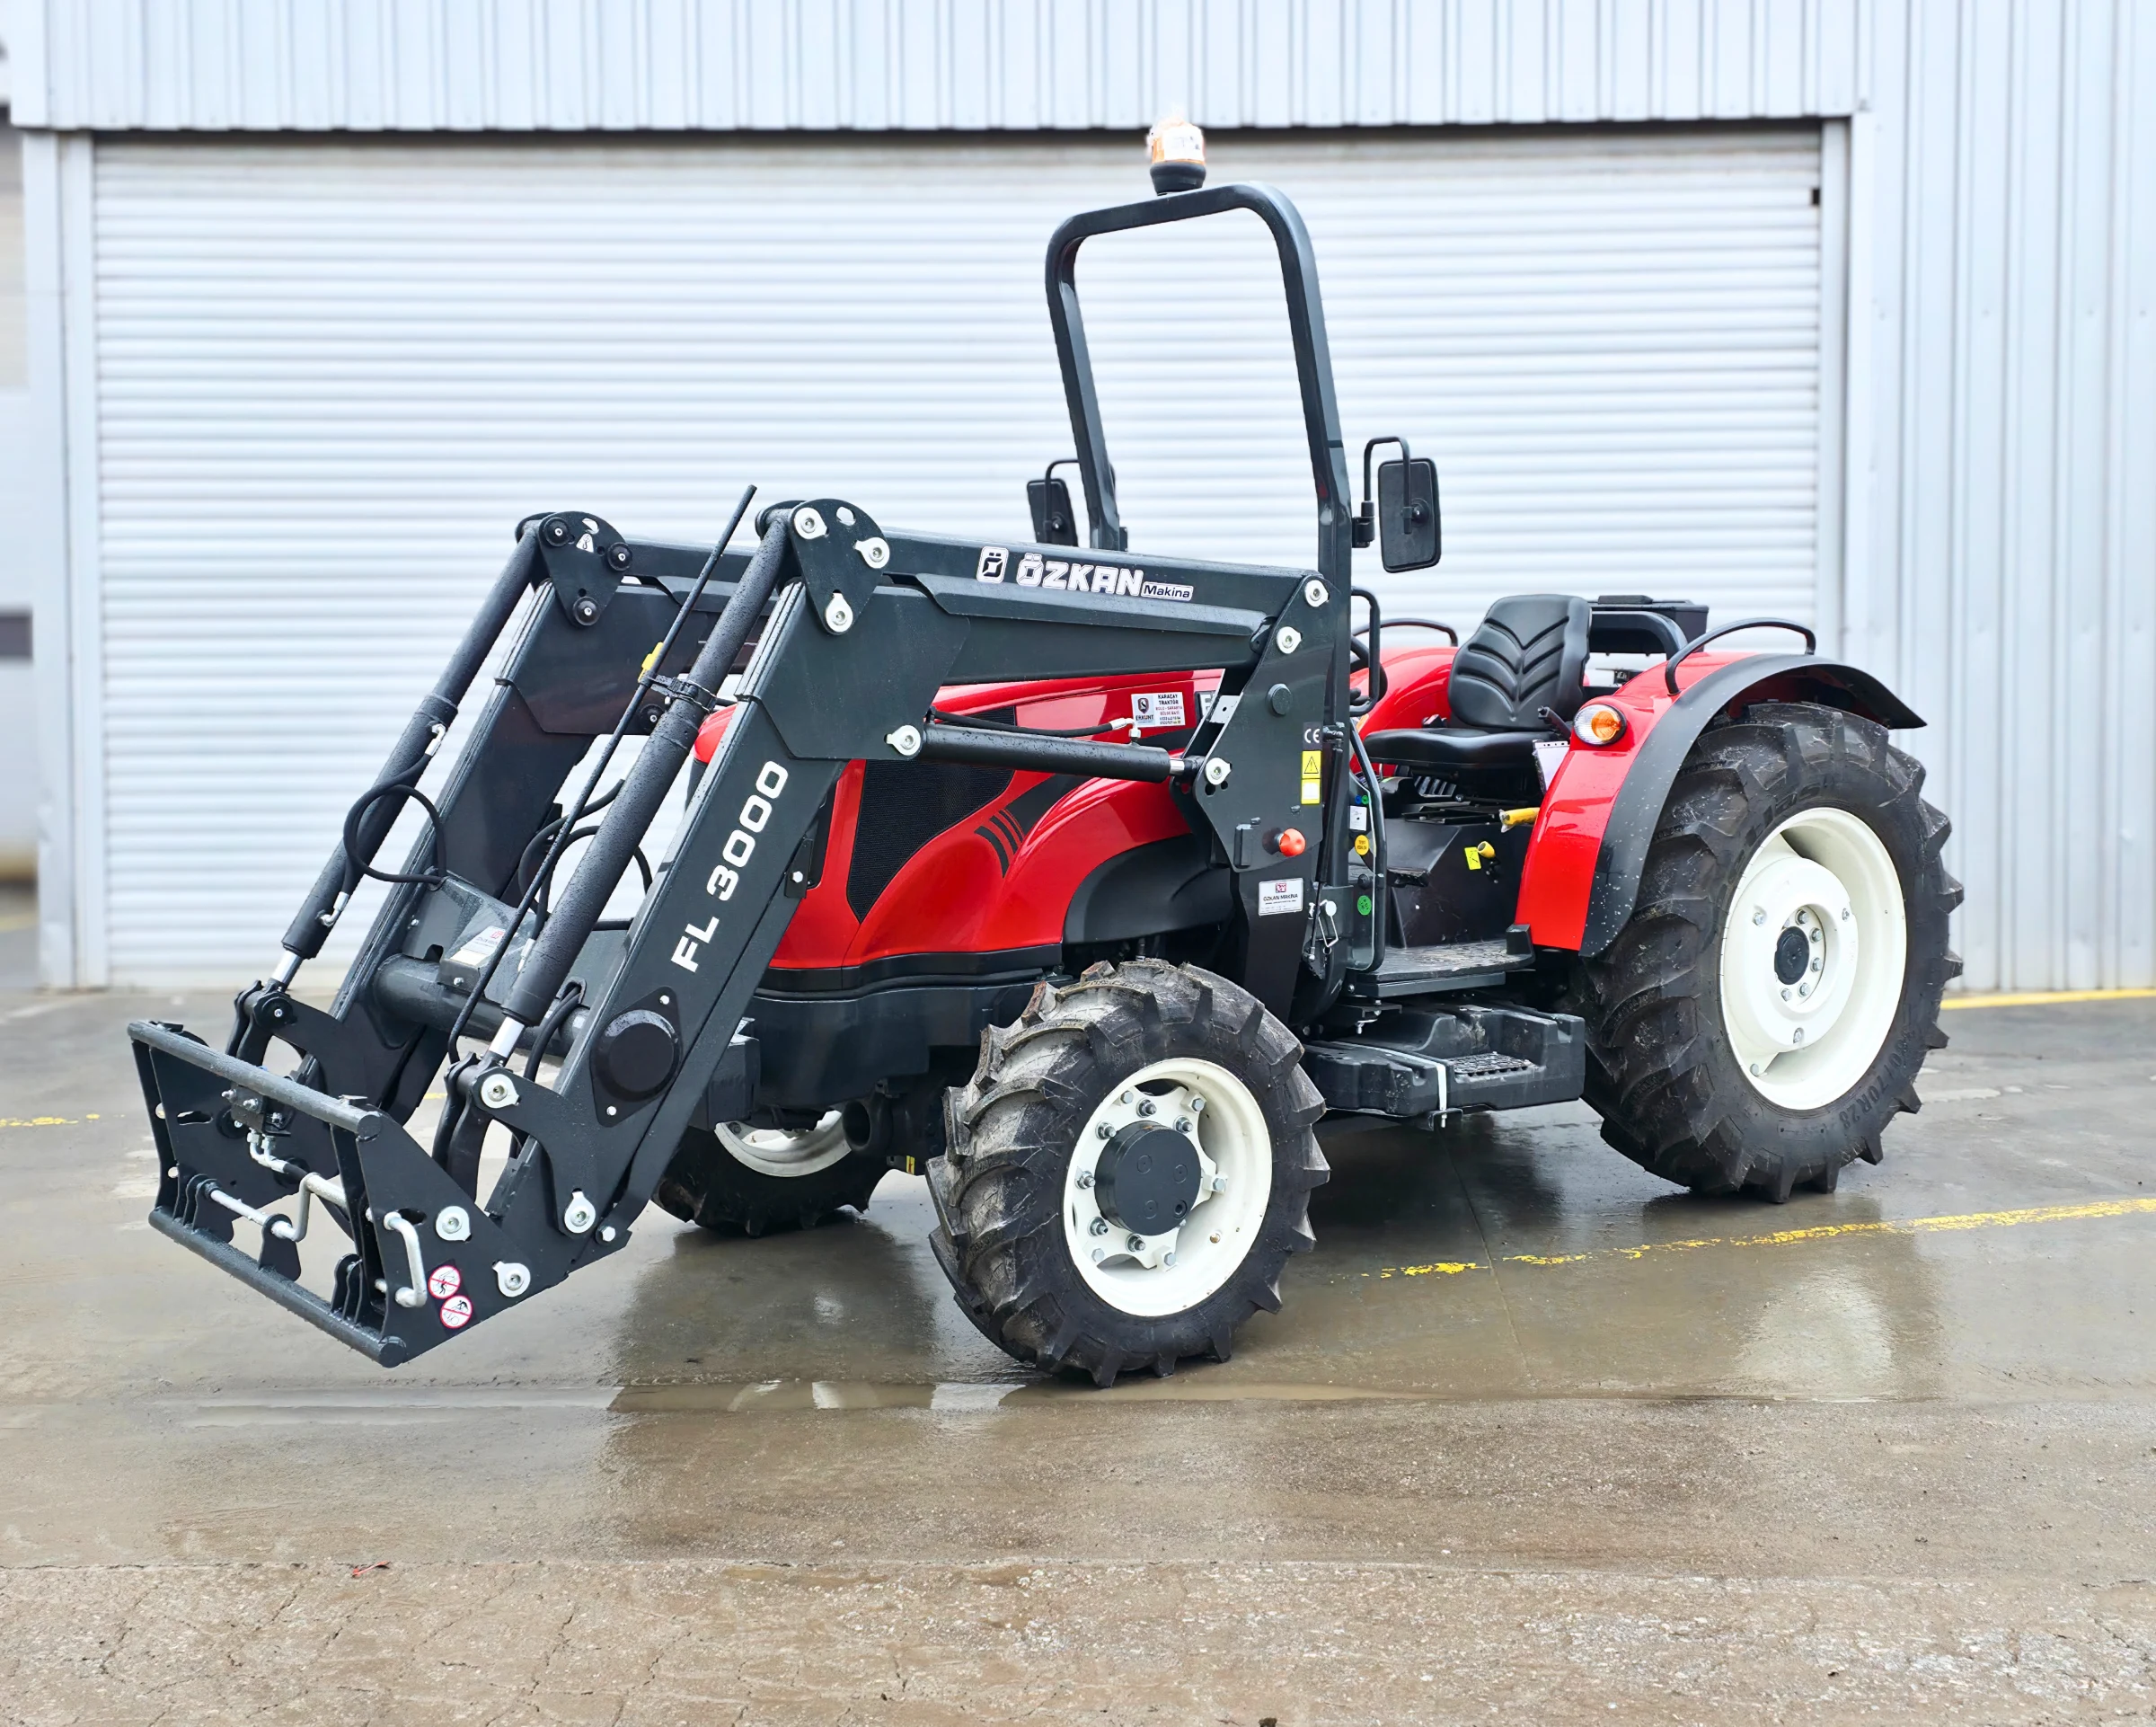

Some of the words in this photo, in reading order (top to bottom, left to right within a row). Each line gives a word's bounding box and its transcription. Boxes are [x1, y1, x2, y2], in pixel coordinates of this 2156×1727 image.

[1016, 553, 1144, 597] ÖZKAN
[1144, 584, 1190, 598] Makina
[1304, 728, 1321, 744] CE
[670, 917, 720, 972] FL
[706, 760, 789, 901] 3000
